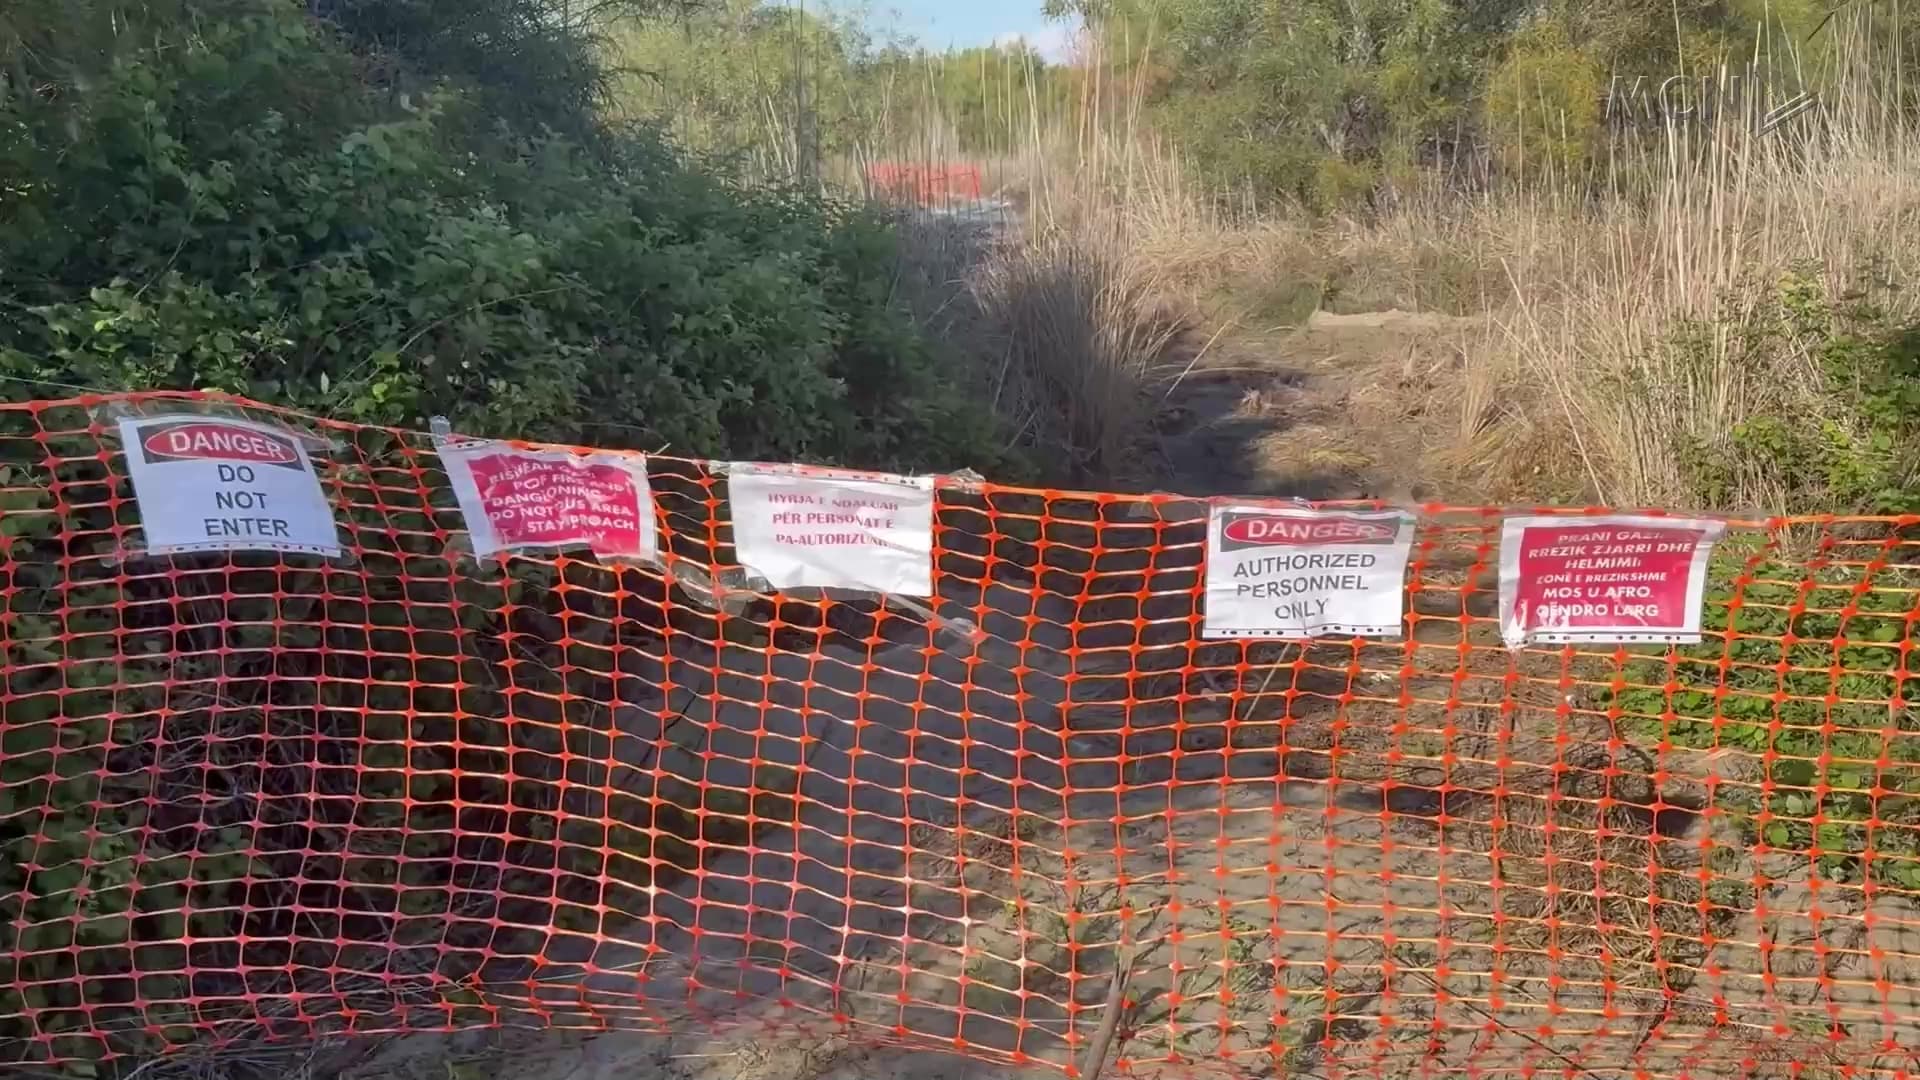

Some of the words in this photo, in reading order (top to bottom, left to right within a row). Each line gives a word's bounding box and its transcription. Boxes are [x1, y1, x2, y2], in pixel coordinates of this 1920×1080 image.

[168, 431, 286, 460] DANGER
[218, 464, 255, 483] DO
[216, 491, 267, 509] NOT
[768, 493, 814, 506] HYRJA
[204, 518, 290, 537] ENTER
[773, 512, 802, 524] PËR
[886, 518, 895, 529] E
[1247, 519, 1378, 540] DANGER
[1528, 545, 1587, 559] RREZIK
[1592, 543, 1652, 556] ZJARRI
[1656, 542, 1692, 553] DHE
[1233, 553, 1376, 579] AUTHORIZED
[1236, 574, 1368, 598] PERSONNEL
[1575, 573, 1582, 583] E
[1585, 572, 1668, 584] RREZIKSHME
[1543, 587, 1584, 600] MOS
[1588, 587, 1600, 598] U
[1274, 598, 1329, 620] ONLY
[1614, 604, 1659, 617] LARG
